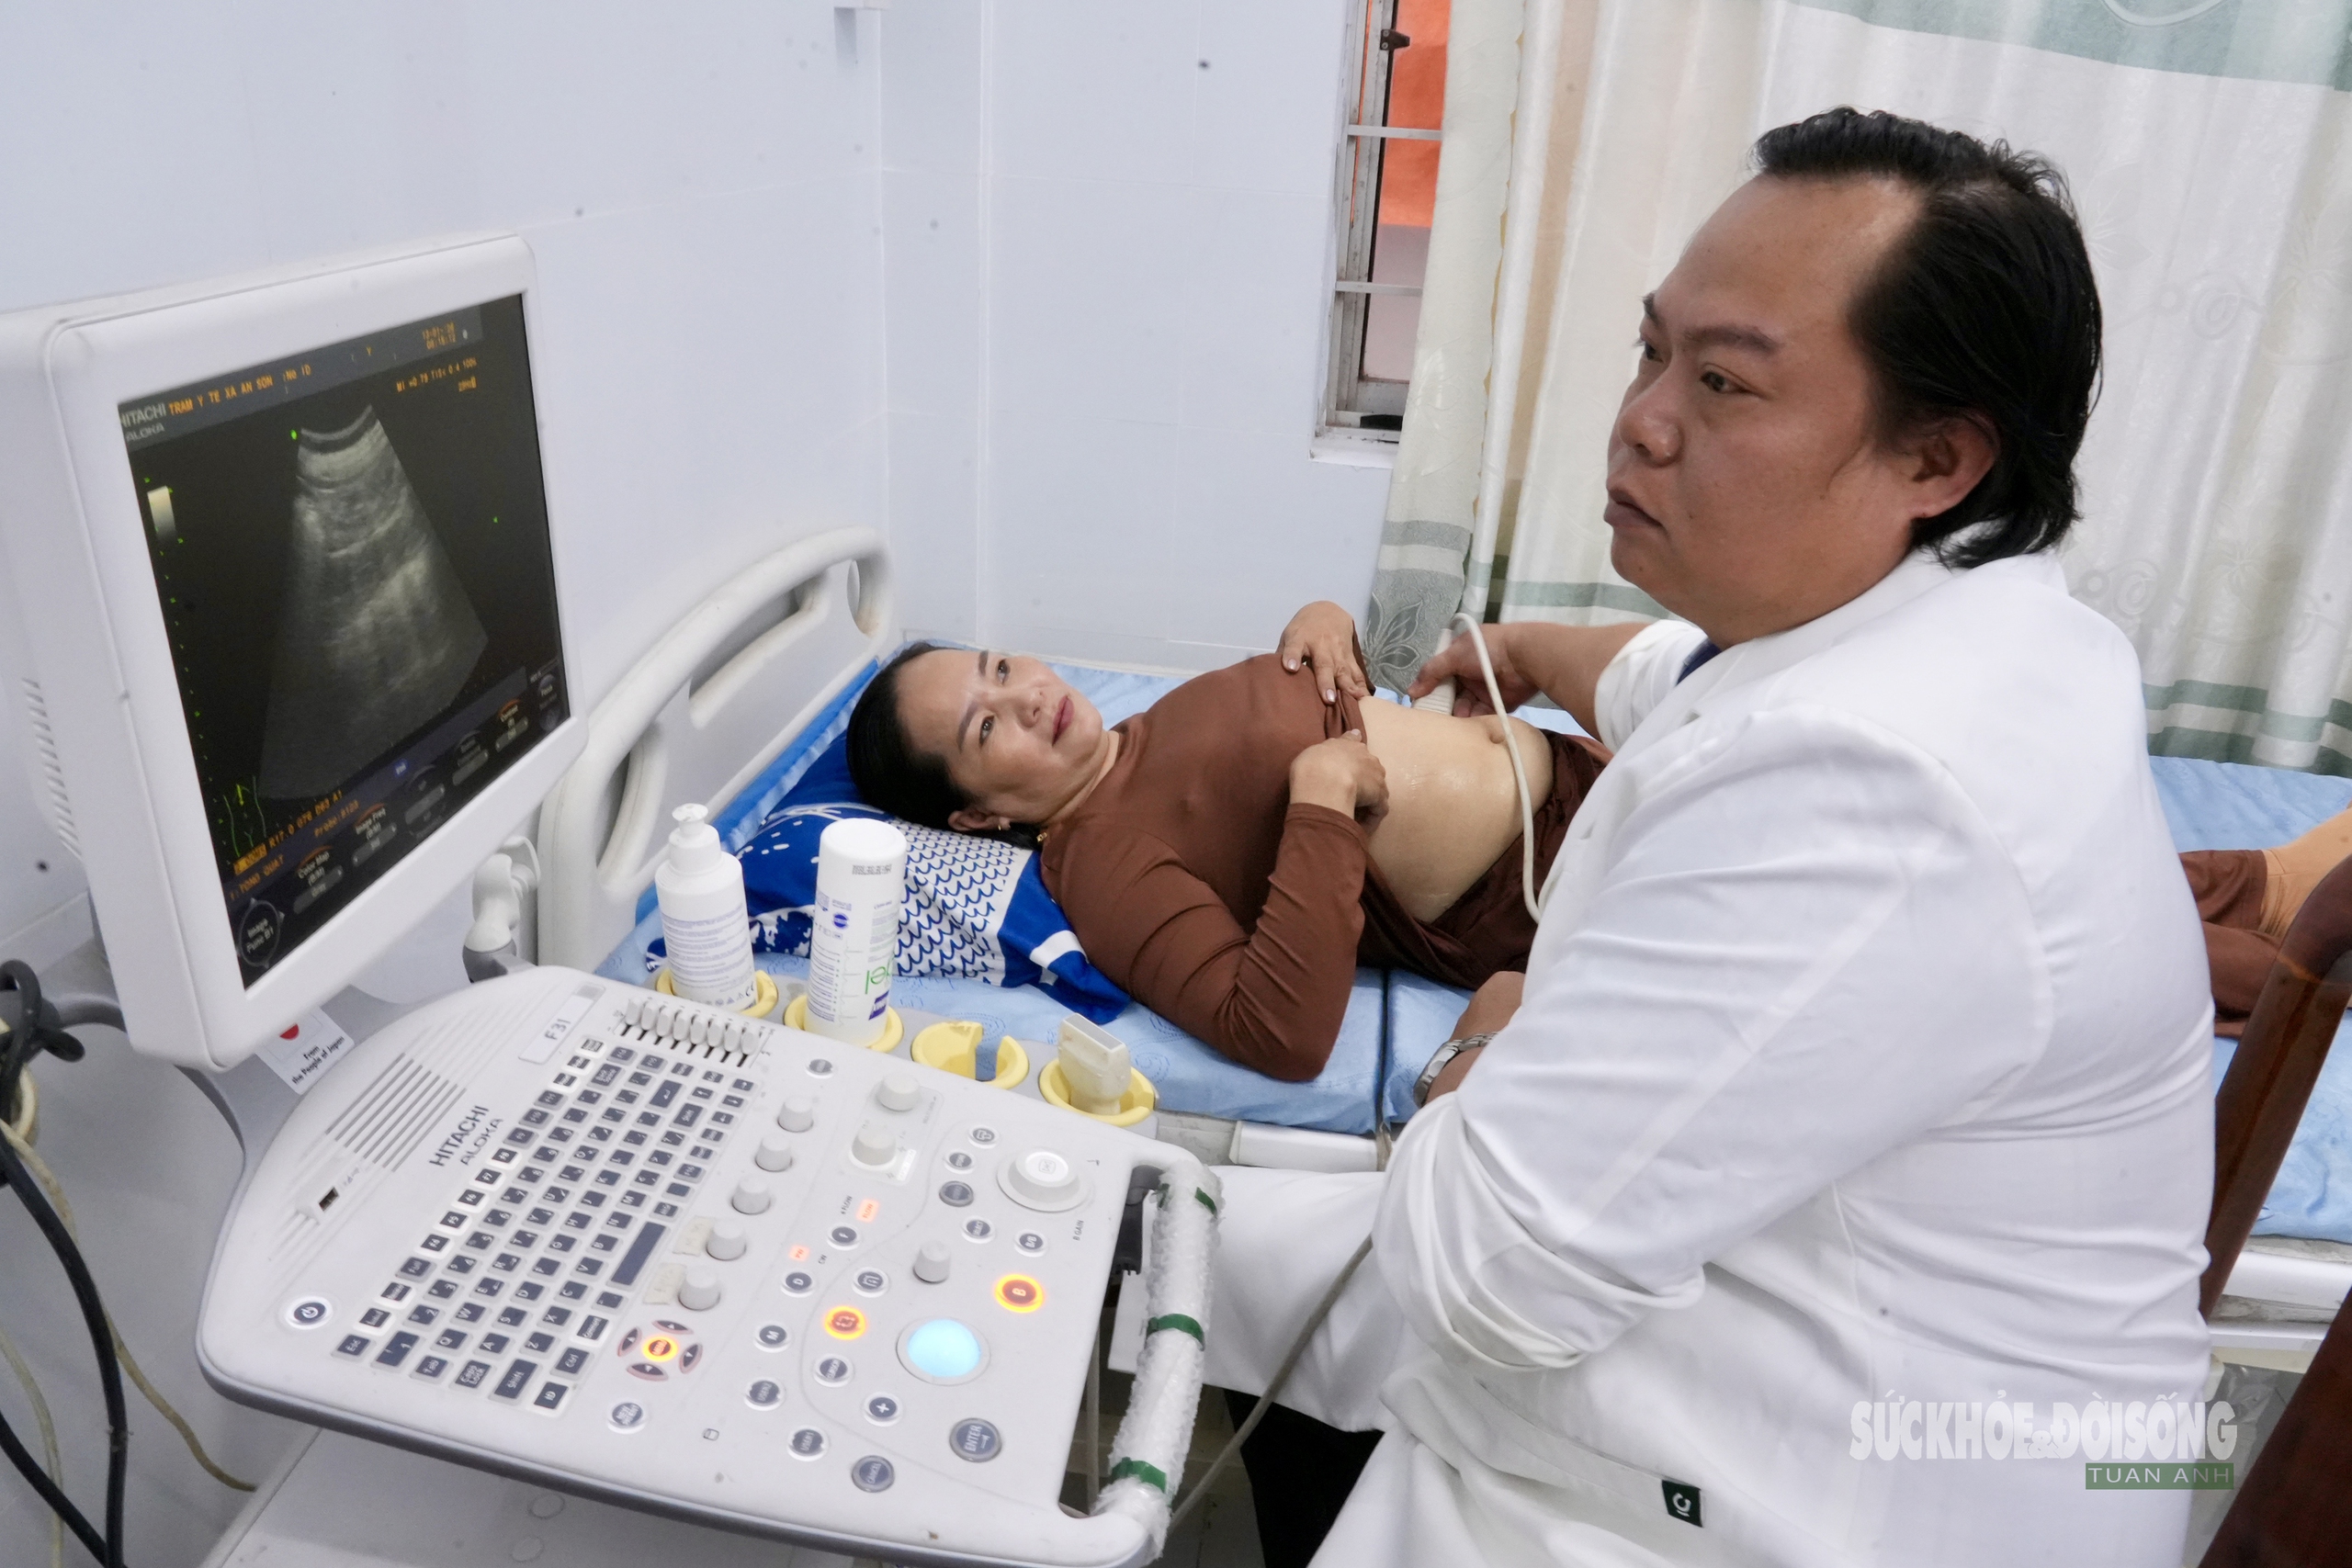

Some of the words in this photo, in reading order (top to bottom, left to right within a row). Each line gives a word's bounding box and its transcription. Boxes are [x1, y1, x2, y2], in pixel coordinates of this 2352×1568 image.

[168, 398, 194, 416] TRAM
[198, 395, 204, 408] Y
[208, 389, 221, 404] TE
[225, 386, 237, 400] XA
[241, 380, 254, 395] AN
[256, 374, 273, 390] SON
[291, 1069, 303, 1086] the
[300, 1052, 322, 1077] People
[326, 1035, 345, 1055] Japan
[303, 1045, 320, 1061] From
[429, 1105, 490, 1167] HITACHI
[461, 1118, 504, 1166] ALOKA
[621, 1194, 635, 1205] M
[1074, 1220, 1083, 1234] GAIN
[1025, 1235, 1037, 1248] B/B
[793, 1277, 804, 1286] D
[1013, 1287, 1026, 1296] B
[458, 1307, 472, 1319] W
[766, 1329, 779, 1340] M
[507, 1370, 525, 1390] Shift
[963, 1425, 982, 1452] ENTER
